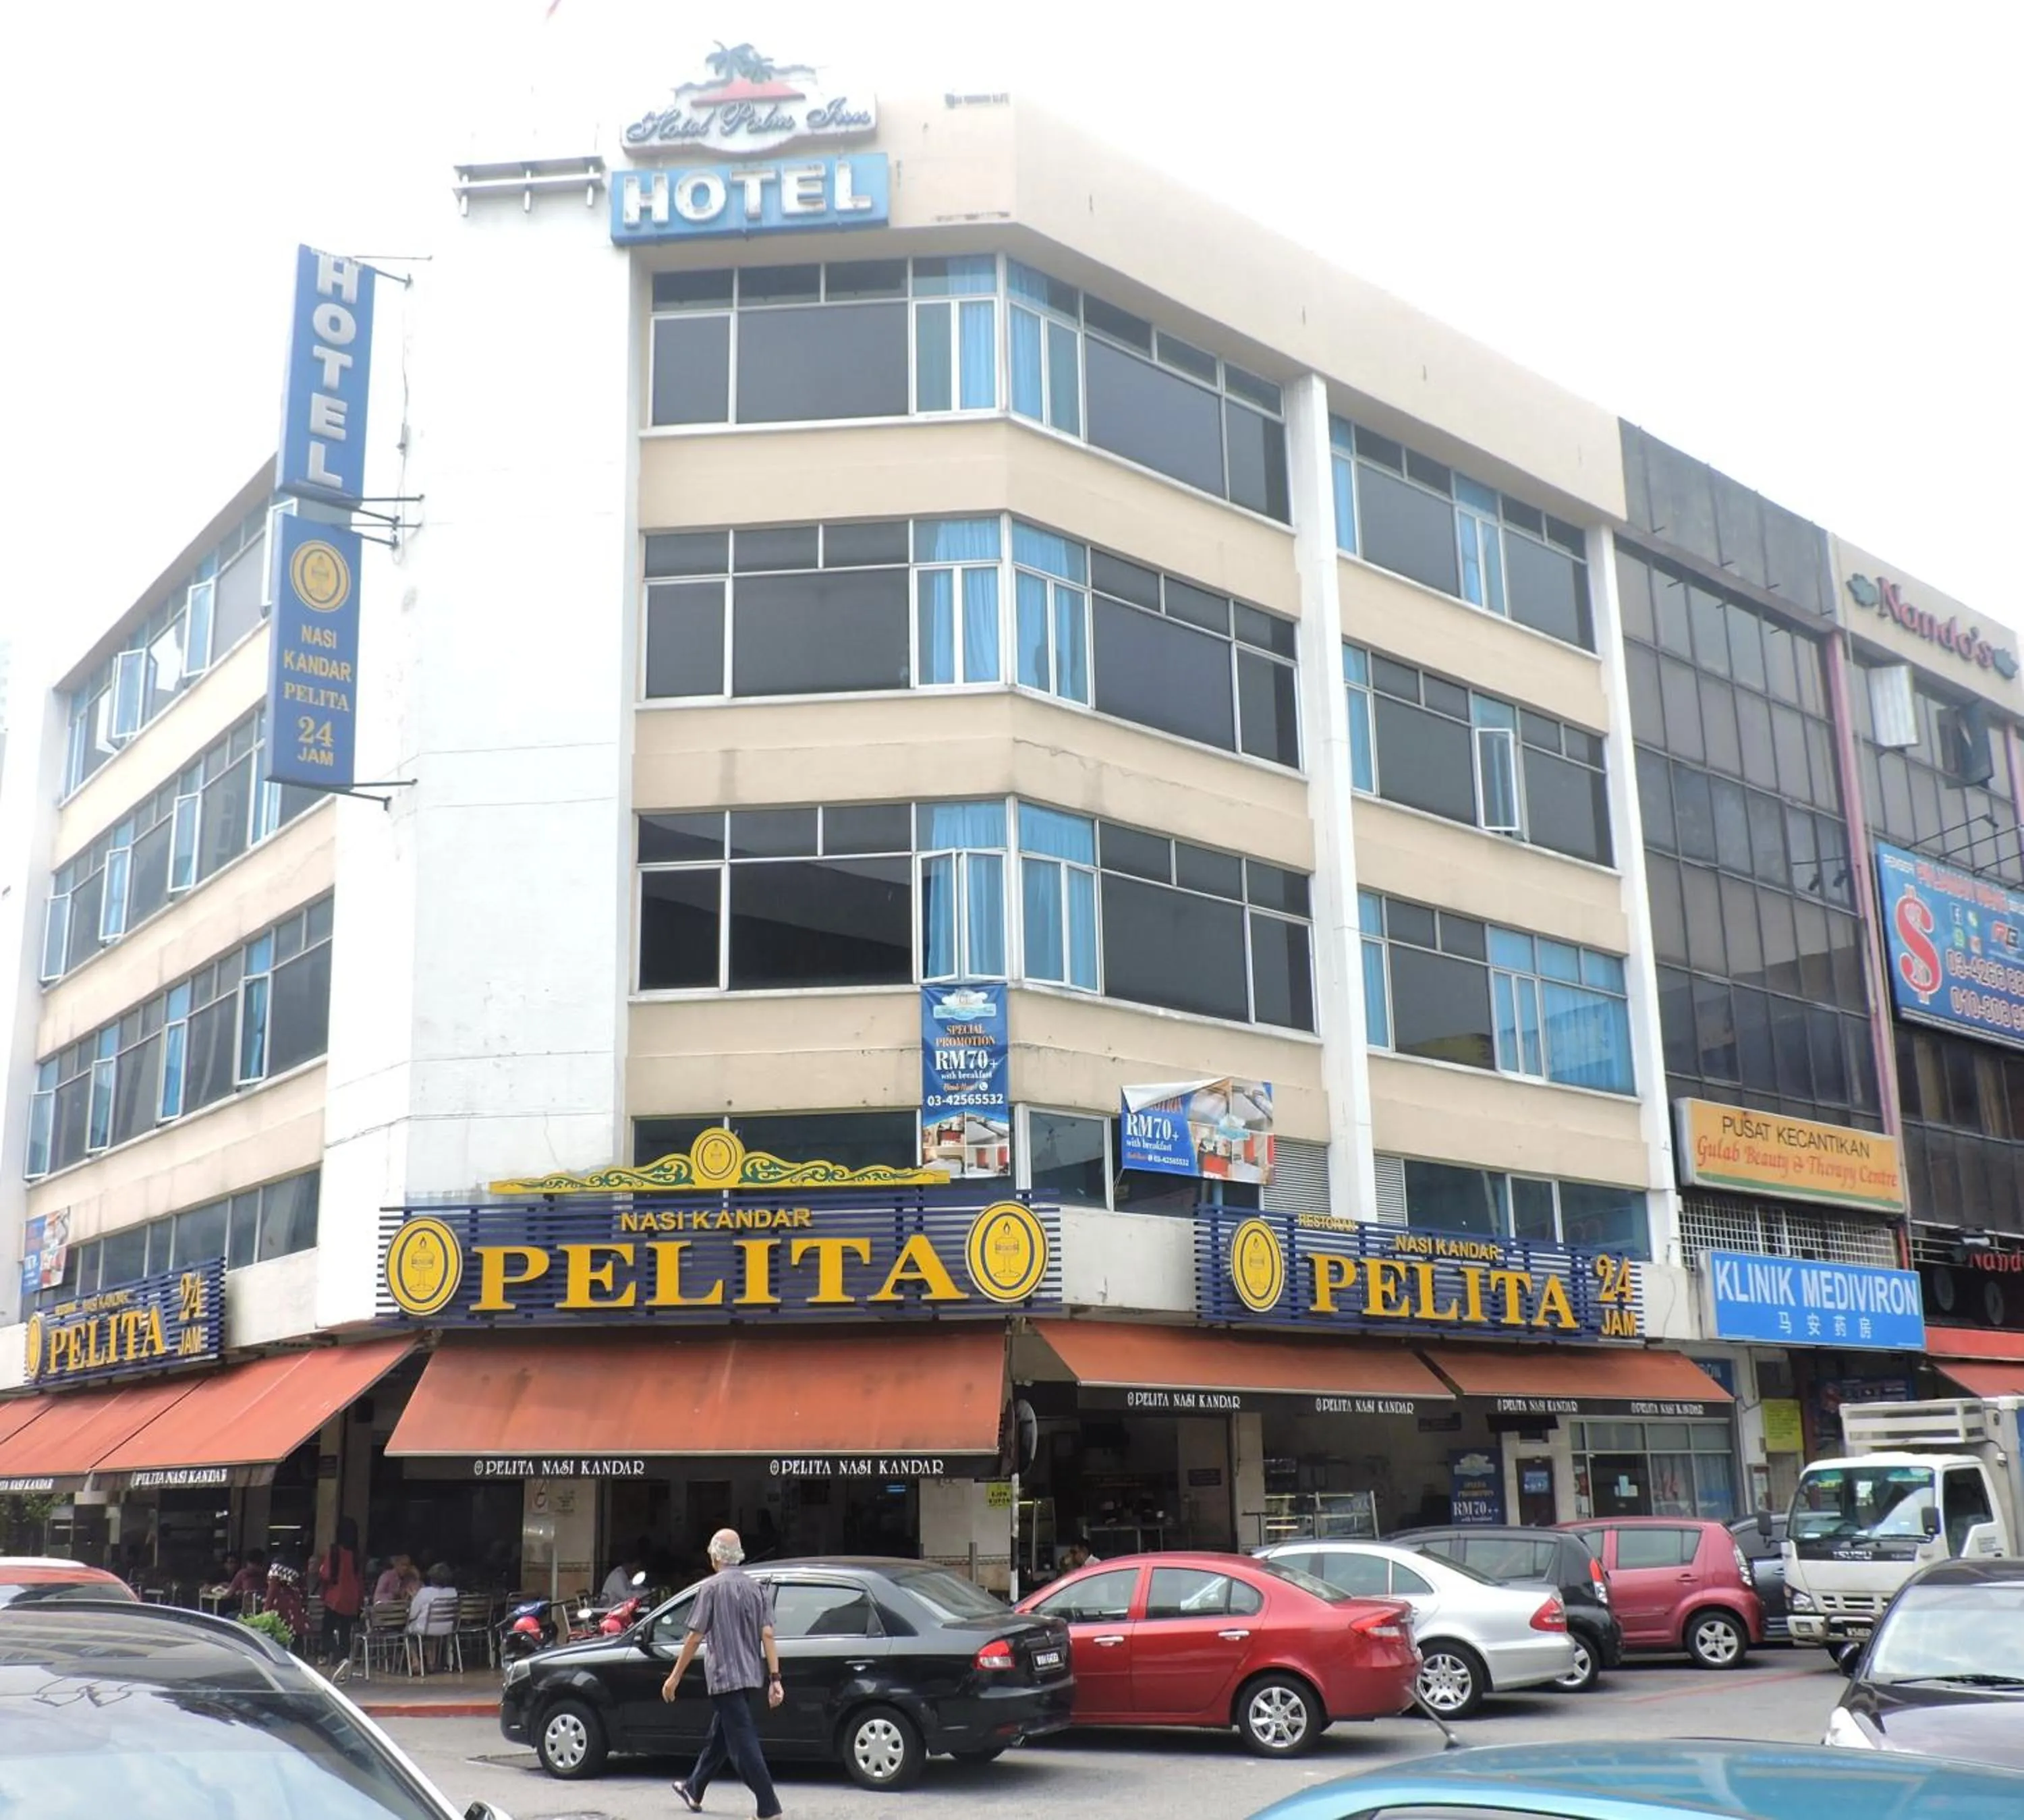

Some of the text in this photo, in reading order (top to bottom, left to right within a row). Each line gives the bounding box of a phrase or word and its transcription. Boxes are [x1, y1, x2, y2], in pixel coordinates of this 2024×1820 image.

[719, 100, 796, 136] Palm
[623, 161, 872, 229] HOTEL
[306, 253, 359, 490] HOTEL
[301, 624, 337, 649] NASI
[1876, 576, 1994, 669] Nando's
[283, 649, 352, 683] KANDAR
[283, 681, 350, 712] PELITA
[298, 715, 333, 748] 24
[297, 746, 334, 767] JAM
[936, 1035, 995, 1048] PROMOTION
[946, 1023, 984, 1035] SPECIAL
[958, 1069, 992, 1079] breakfast
[927, 1093, 1004, 1106] 03-42565532
[1126, 1137, 1172, 1152] with breakfast
[1722, 1114, 1870, 1159] PUSAT KECANTIKAN
[1696, 1135, 1739, 1166] Gulab
[1744, 1145, 1789, 1178] Beauty
[1807, 1155, 1856, 1190] Therapy
[1859, 1164, 1898, 1188] Centre
[620, 1207, 813, 1232] NASI KANDAR
[1297, 1214, 1357, 1231] RESTORAN
[1395, 1234, 1500, 1261] NASI KANDAR
[469, 1234, 970, 1311] PELITA
[1595, 1253, 1633, 1303] 24
[1714, 1259, 1919, 1316] KLINIK MEDIVIRON
[178, 1272, 202, 1321] 24
[1307, 1253, 1579, 1330] PELITA
[1601, 1310, 1637, 1338] JAM
[47, 1305, 167, 1374] PELITA
[177, 1326, 202, 1356] JAM
[1135, 1392, 1241, 1409] PELITA NASI KANDAR
[1322, 1398, 1415, 1415] PELITA NASI KANDAR
[485, 1460, 644, 1475] PELITA NASI KANDAR
[781, 1460, 945, 1475] PELITA NASI KANDAR
